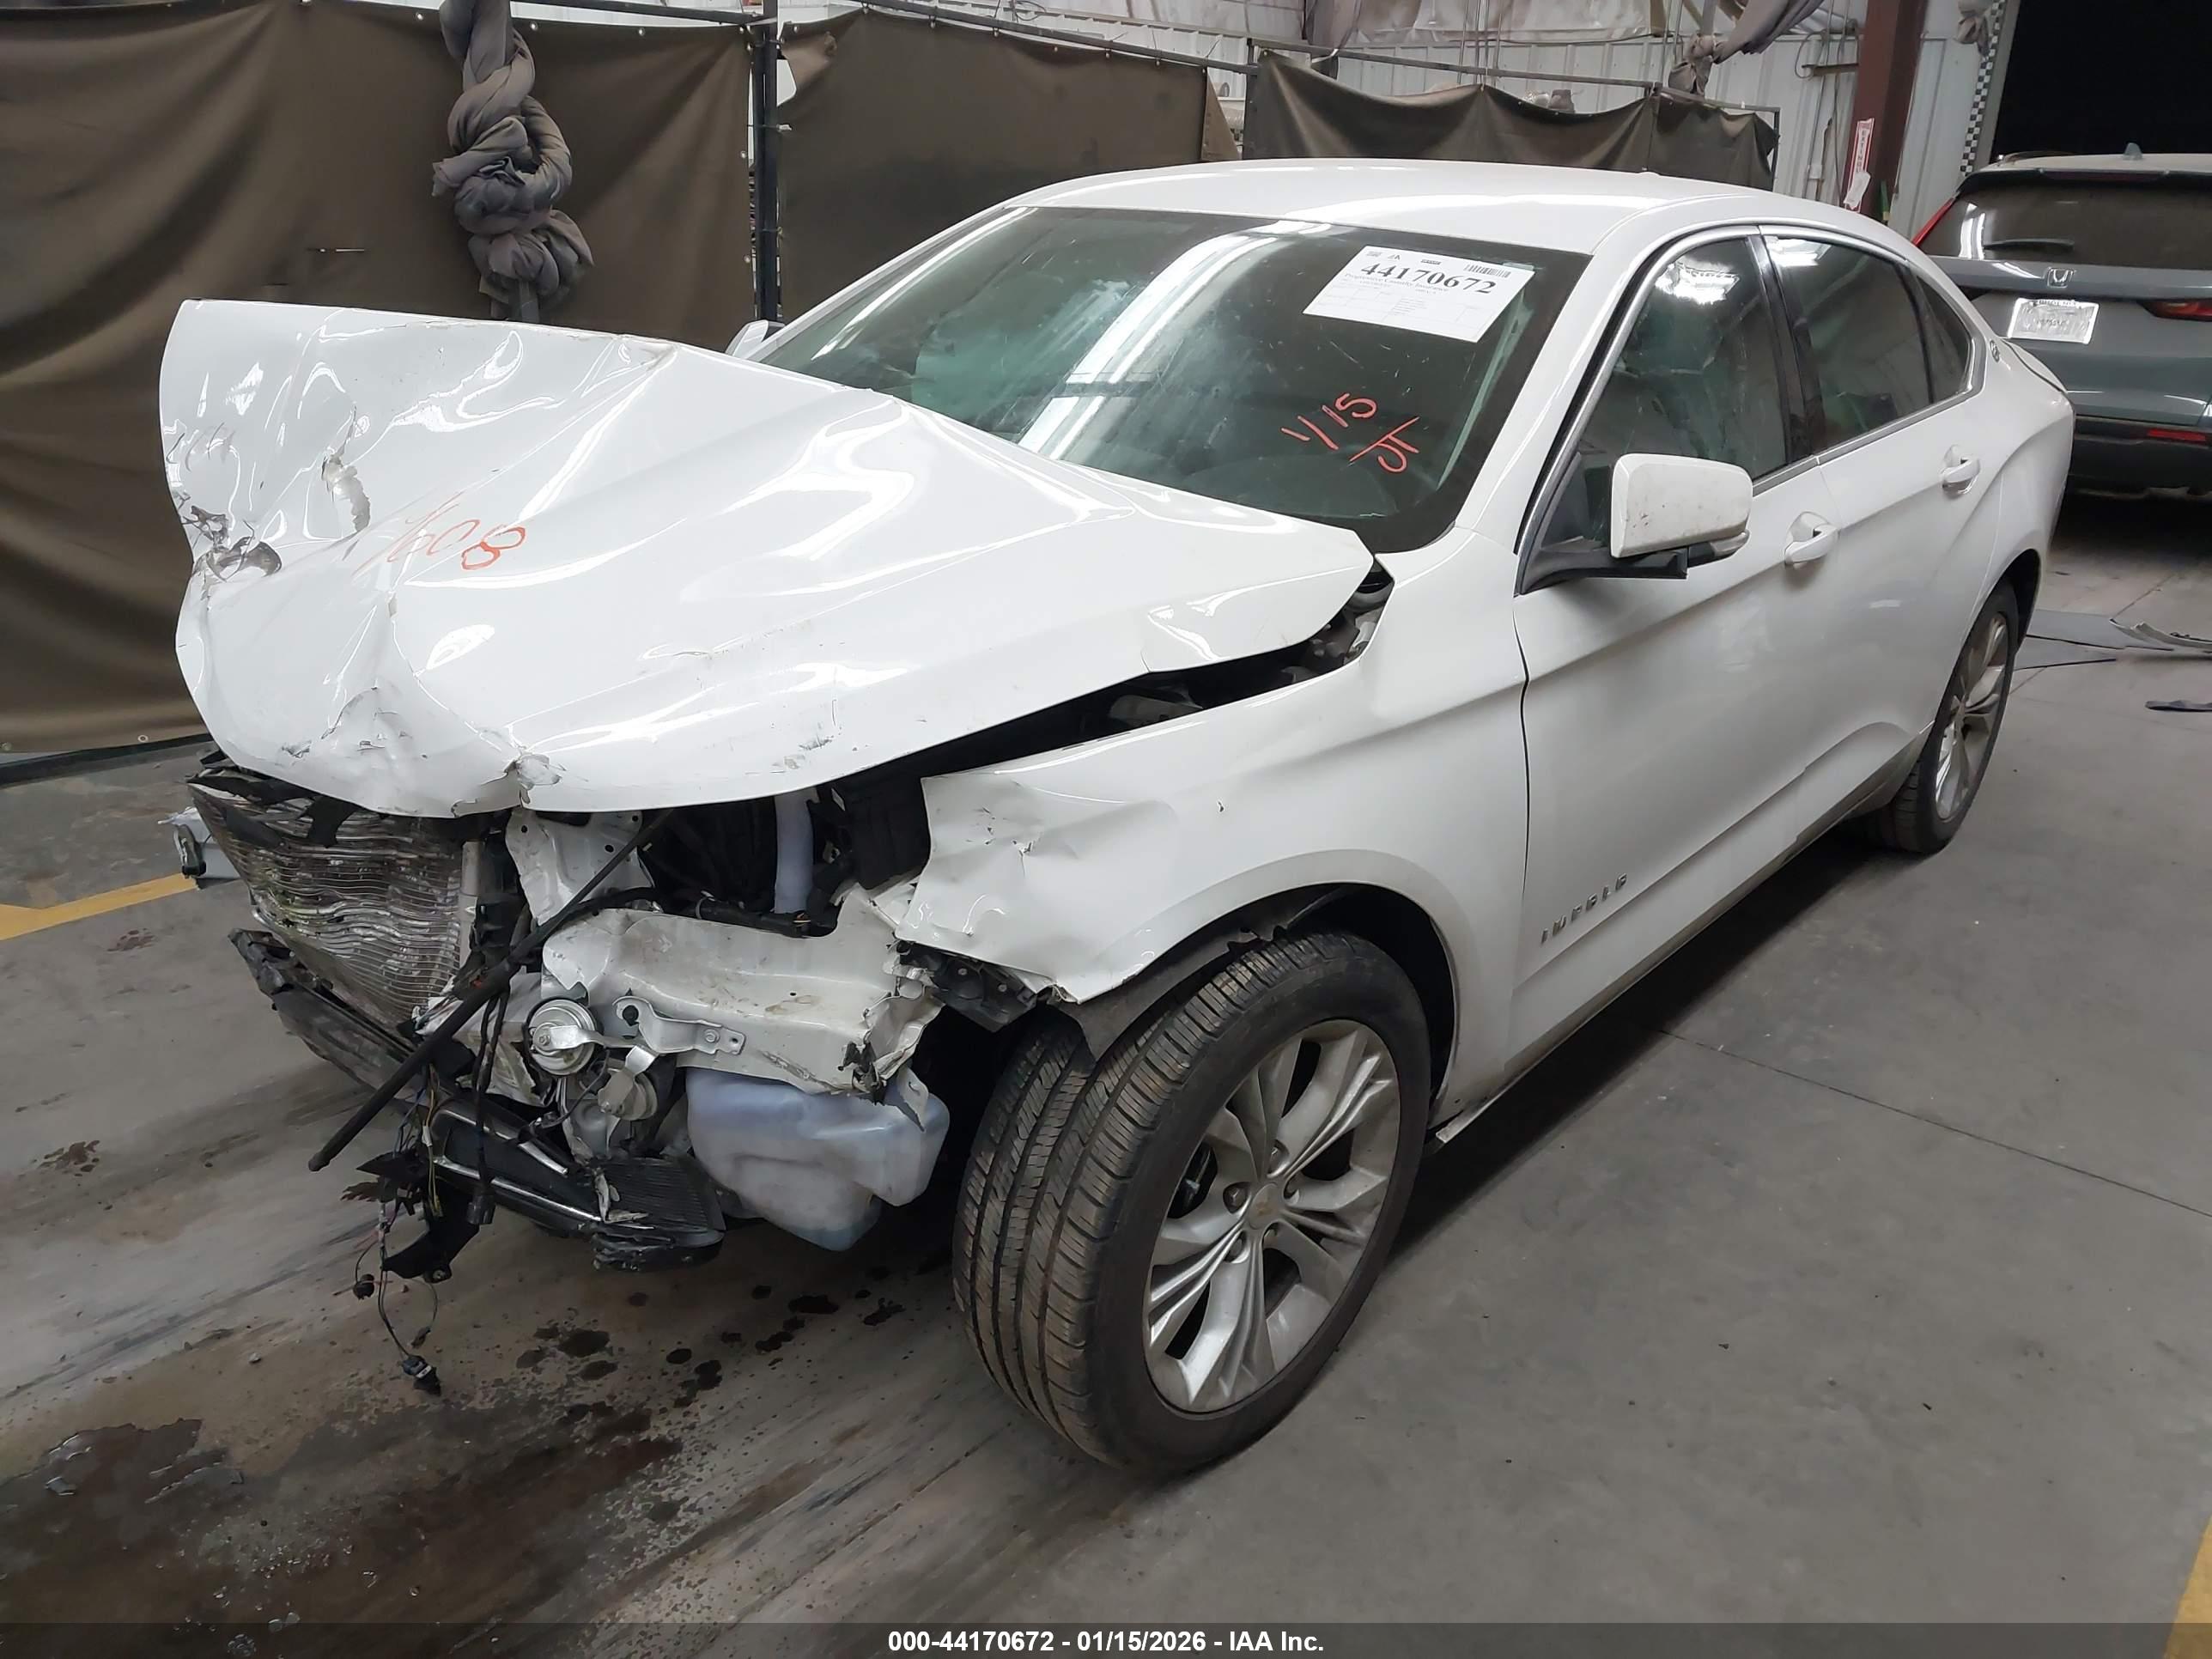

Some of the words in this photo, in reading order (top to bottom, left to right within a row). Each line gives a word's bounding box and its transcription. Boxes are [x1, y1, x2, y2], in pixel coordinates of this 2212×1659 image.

[1361, 263, 1496, 294] 44170672
[1280, 392, 1378, 451] 1/15
[1541, 872, 1627, 945] IMPALA
